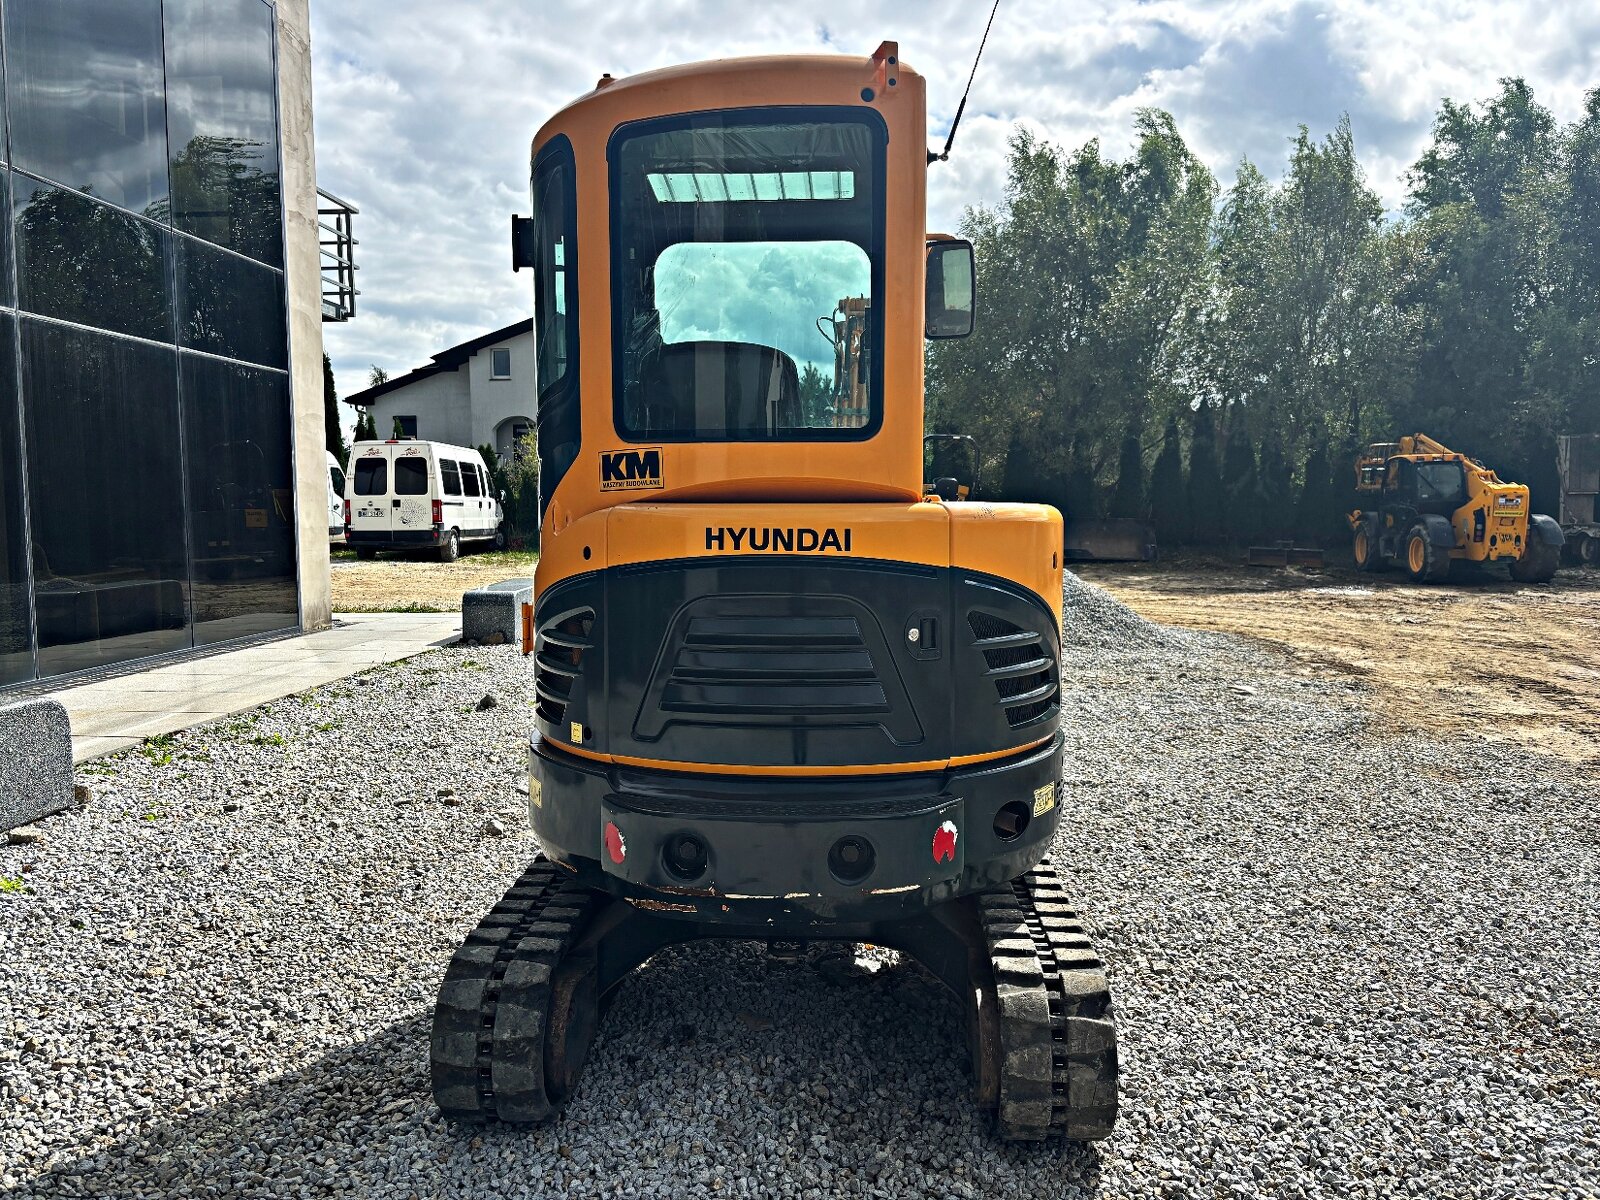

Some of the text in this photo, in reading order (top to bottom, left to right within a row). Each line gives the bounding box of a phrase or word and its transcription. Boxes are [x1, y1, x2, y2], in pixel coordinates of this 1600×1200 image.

[602, 451, 660, 481] KM
[625, 479, 661, 487] BUDOWLANE
[705, 527, 851, 551] HYUNDAI
